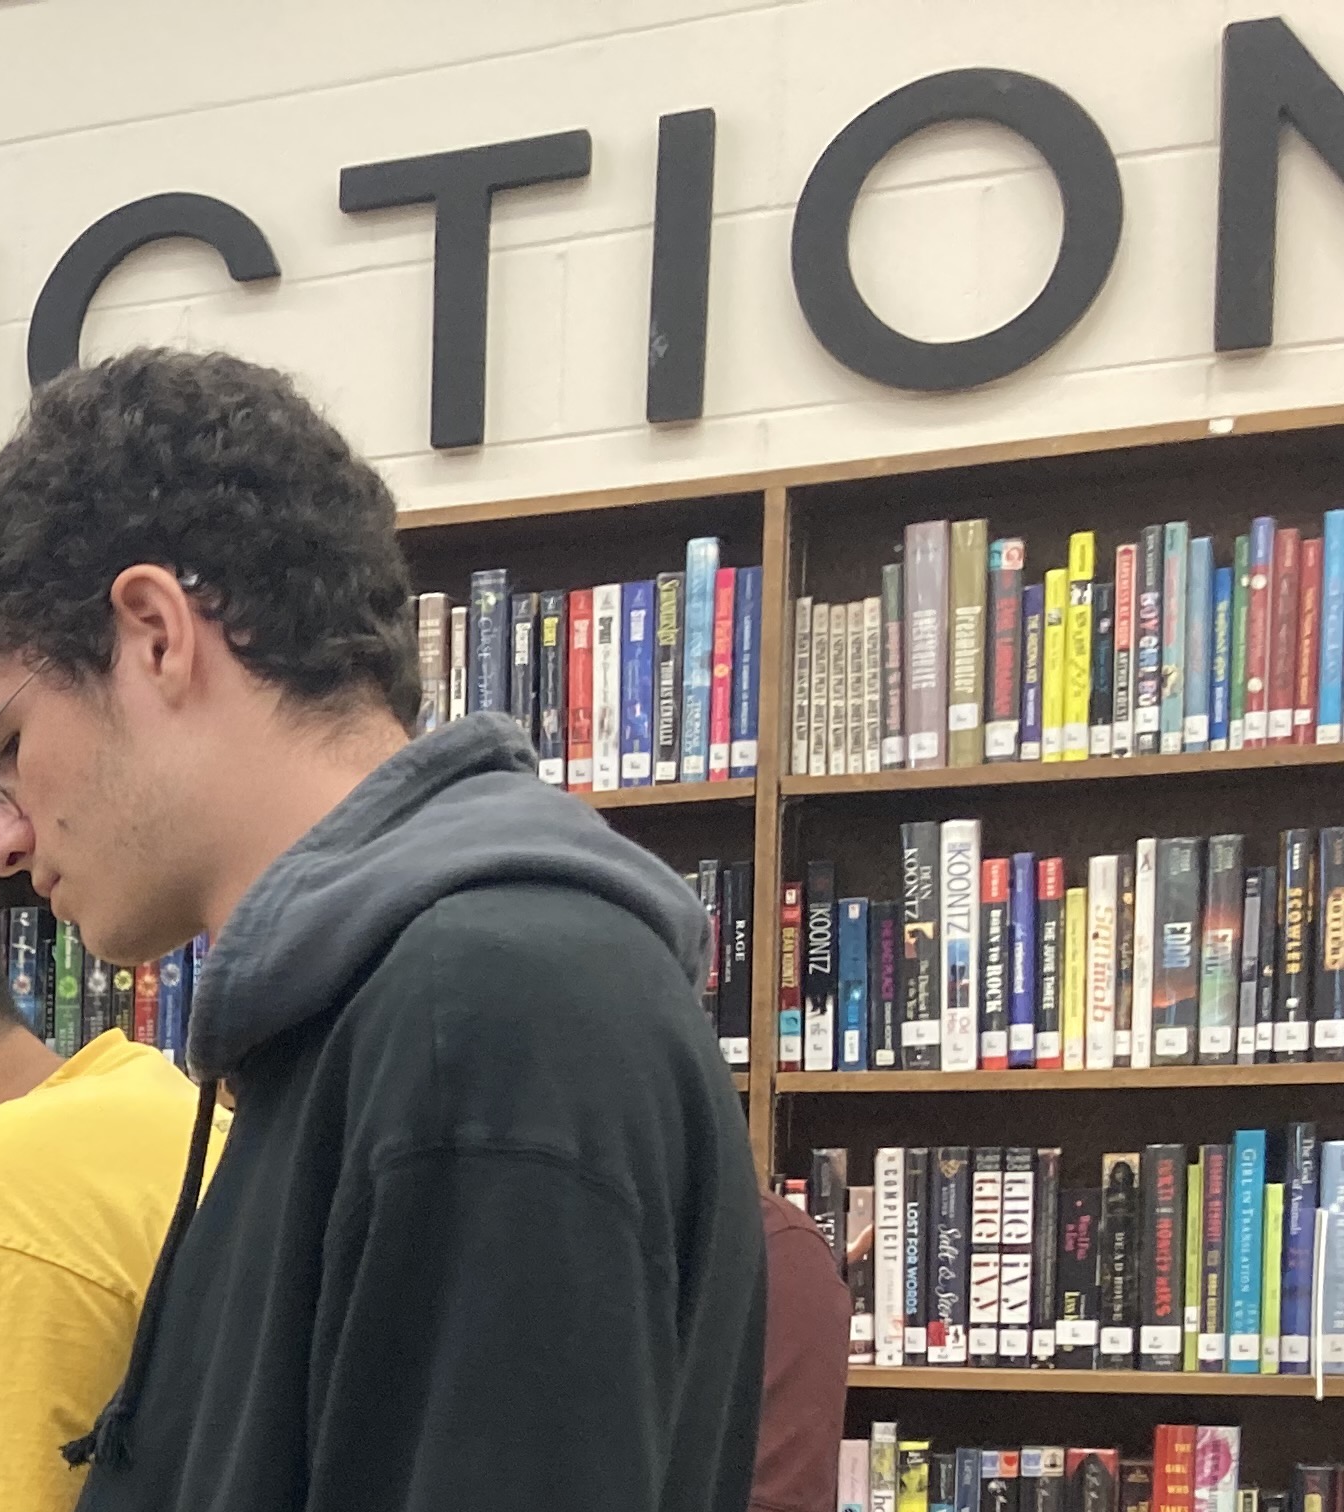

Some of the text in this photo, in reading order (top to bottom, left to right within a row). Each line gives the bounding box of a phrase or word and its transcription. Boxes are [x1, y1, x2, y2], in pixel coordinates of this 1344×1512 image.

[1140, 680, 1158, 706] BO
[904, 847, 920, 922] KOONTZ
[946, 848, 972, 936] KOONTZ
[734, 920, 746, 962] RAGE
[808, 908, 832, 975] KOONTZ
[1285, 886, 1304, 974] SCOWLER
[984, 964, 1003, 1014] ROCK
[1242, 1148, 1258, 1186] GIRL
[1300, 1136, 1315, 1184] The God
[906, 1202, 918, 1314] LOST FOR WORDS
[936, 1224, 962, 1260] Salt
[938, 1266, 956, 1286] &
[973, 1260, 998, 1312] ivy
[1002, 1260, 1030, 1312] ivy
